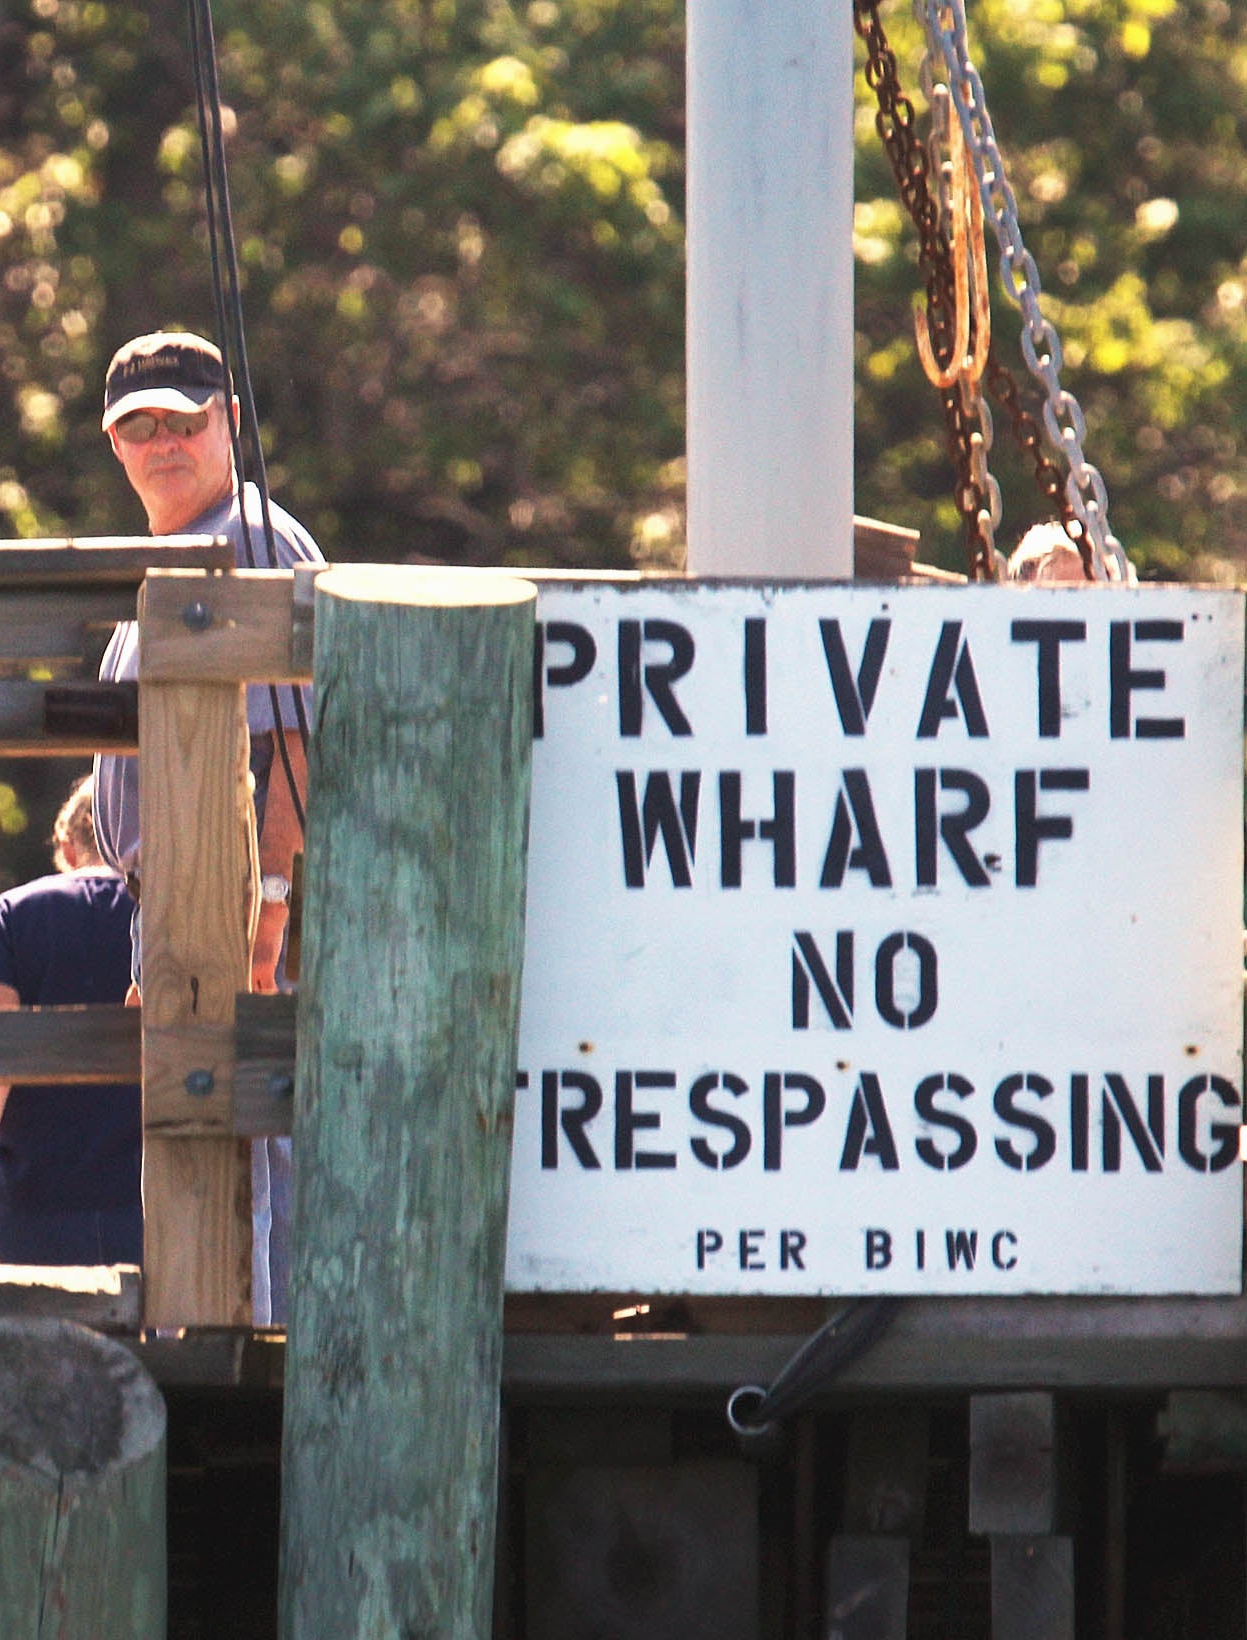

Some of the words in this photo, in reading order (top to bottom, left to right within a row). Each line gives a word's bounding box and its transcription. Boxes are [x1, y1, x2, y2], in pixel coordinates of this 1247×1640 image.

[533, 617, 1186, 740] PRIVATE
[615, 768, 1091, 889] WHARF
[792, 930, 939, 1030] NO
[696, 1229, 808, 1271] PER
[865, 1228, 1018, 1271] BIWC
